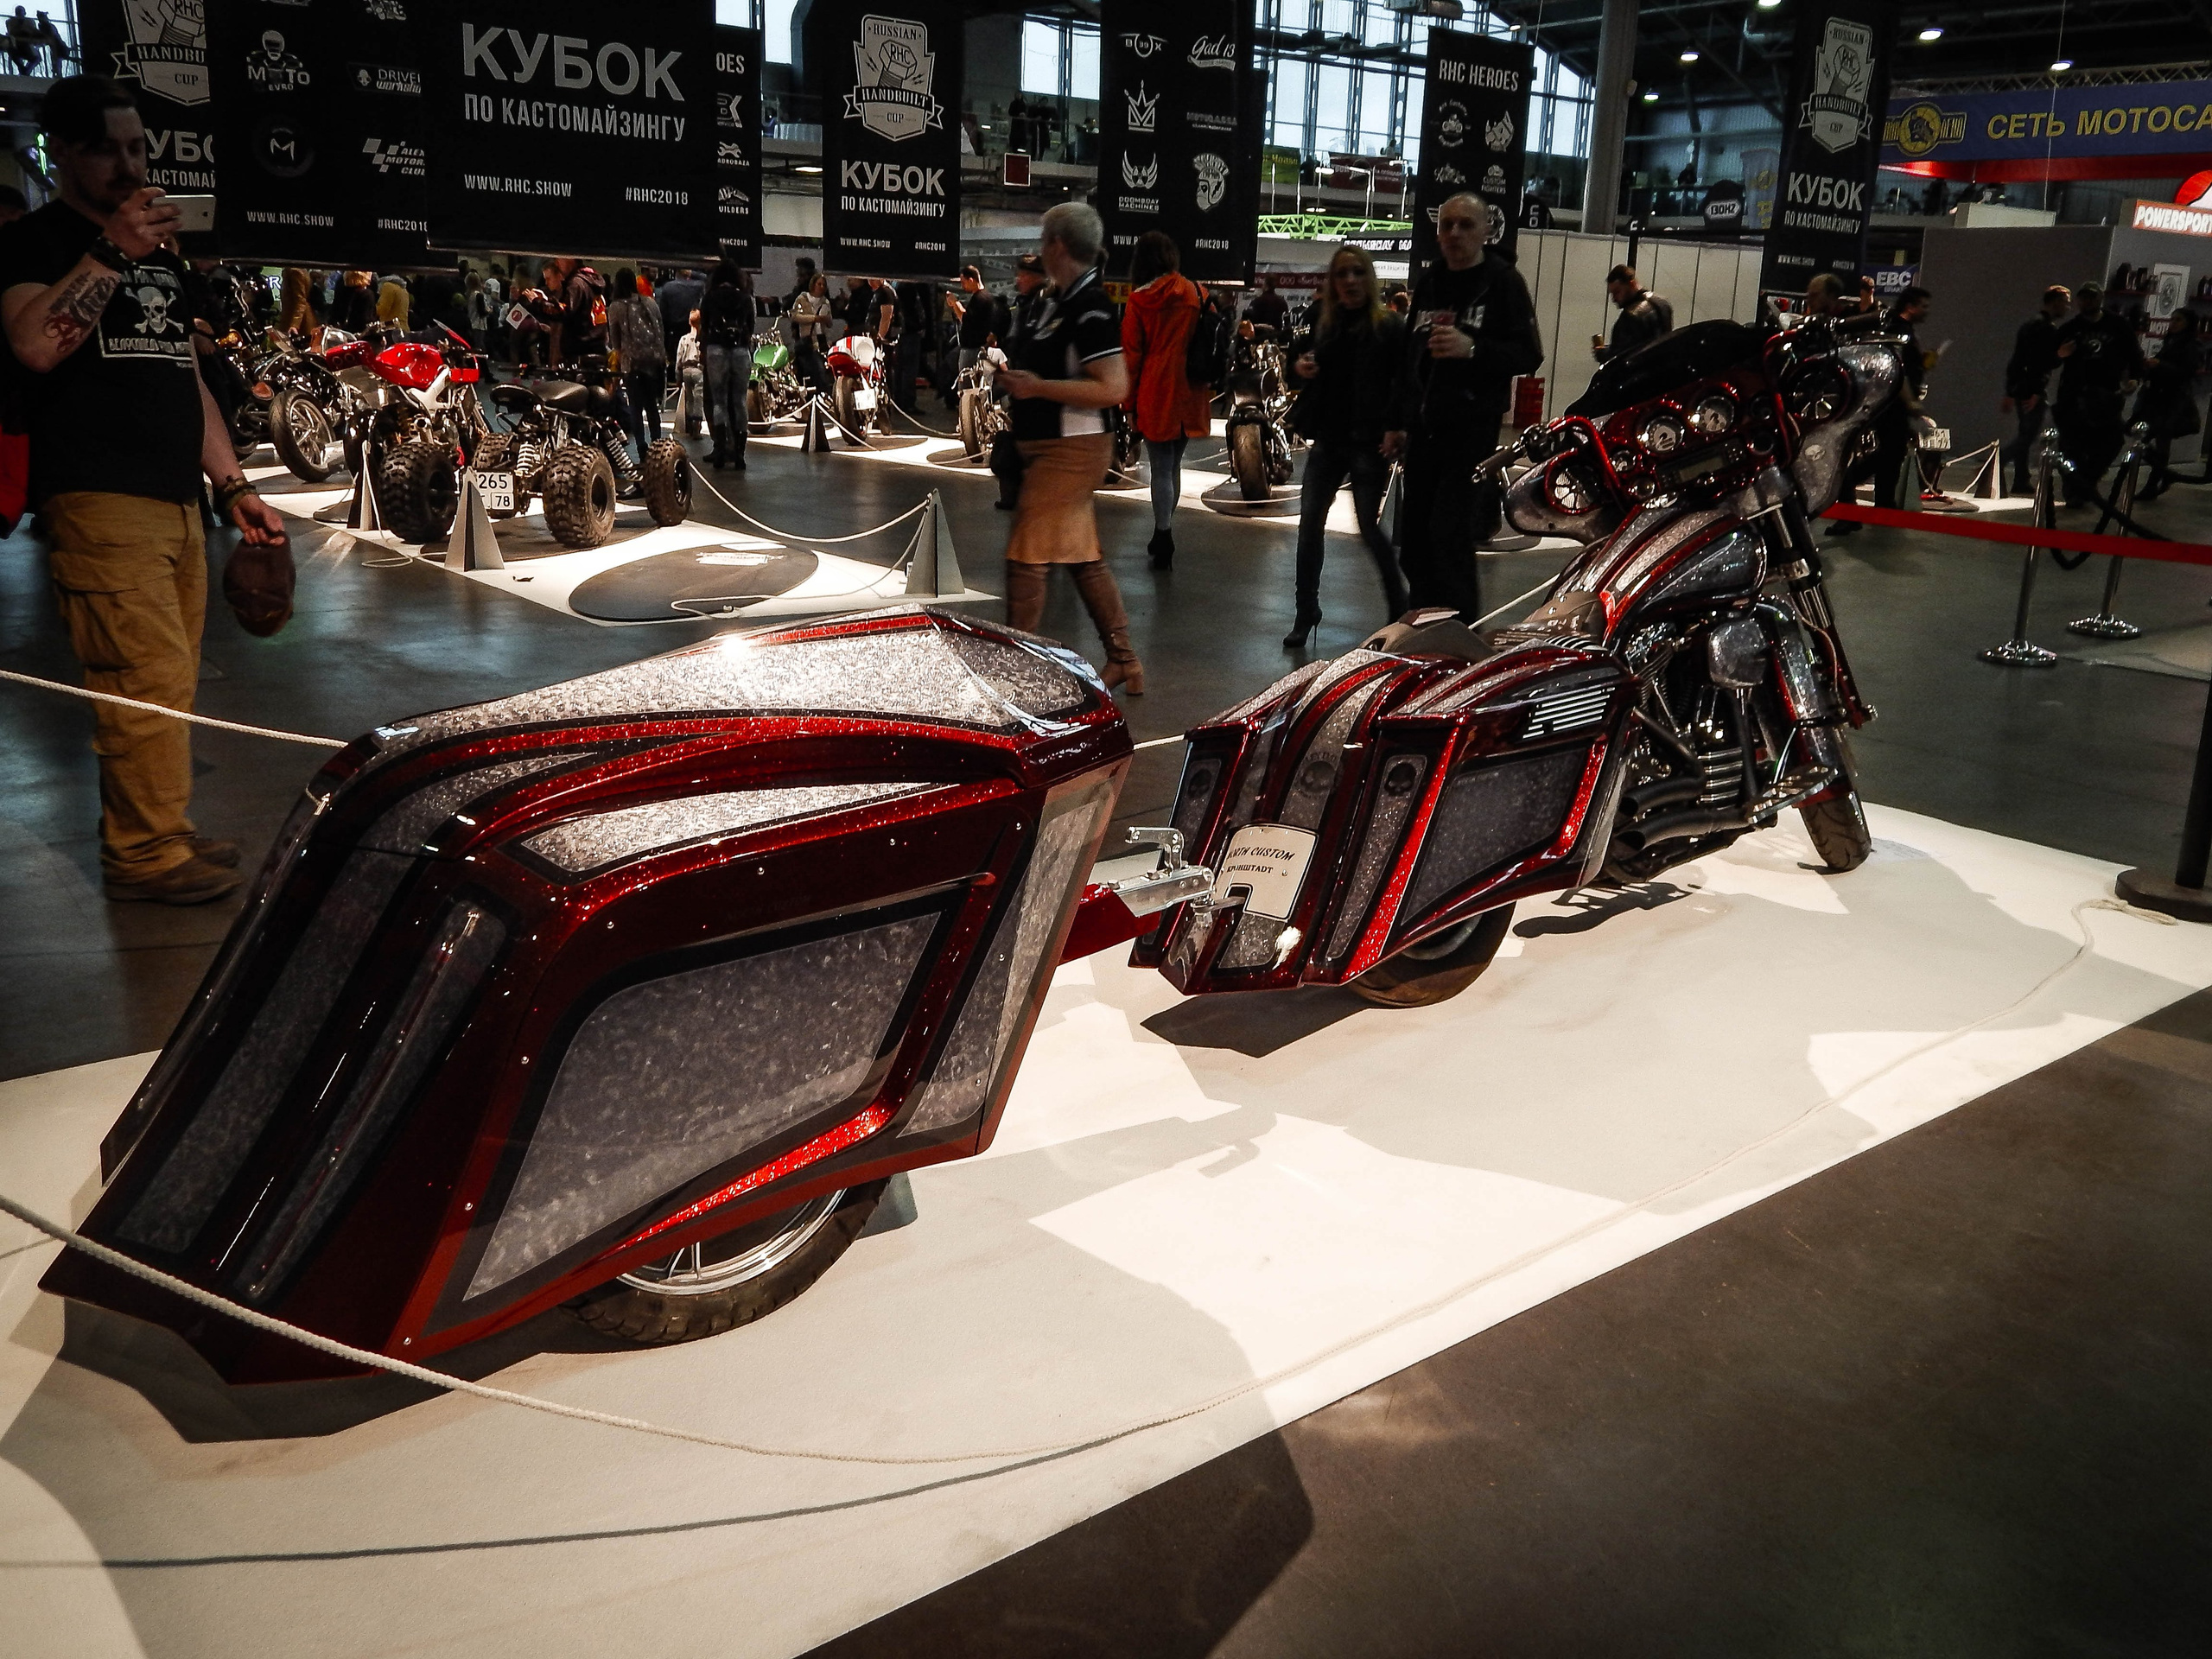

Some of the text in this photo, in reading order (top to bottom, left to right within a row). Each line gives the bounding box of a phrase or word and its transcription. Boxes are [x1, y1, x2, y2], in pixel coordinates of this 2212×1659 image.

[873, 23, 917, 40] RUSSIAN
[1832, 28, 1865, 44] RUSSIAN
[461, 22, 685, 102] КУБОК
[890, 43, 911, 65] RHC
[175, 73, 199, 86] CUP
[1439, 59, 1519, 92] RHC HEROES
[862, 87, 929, 107] HANDBUILT
[464, 93, 493, 124] ПО
[502, 98, 685, 143] КАСТОМАЙЗИНГУ
[887, 112, 904, 123] CUP
[1987, 104, 2212, 140] СЕТЬ МОТОСА
[464, 174, 572, 197] WWW.RHC.SHOW
[842, 159, 945, 196] КУБОК
[625, 187, 689, 206] #RHC2018
[1787, 172, 1866, 212] КУБОК
[842, 195, 945, 218] ПО КАСТОМАЙЗИНГУ
[246, 211, 334, 226] WWW.RHC.SHOW
[1784, 210, 1796, 226] ПО
[1796, 212, 1861, 235] КАСТОМАЙЗИНГУ
[1195, 238, 1230, 250] #RHC2018
[1876, 271, 1911, 287] EBC
[478, 474, 508, 489] 265
[495, 495, 511, 507] 78
[1250, 846, 1295, 861] CUSTOM
